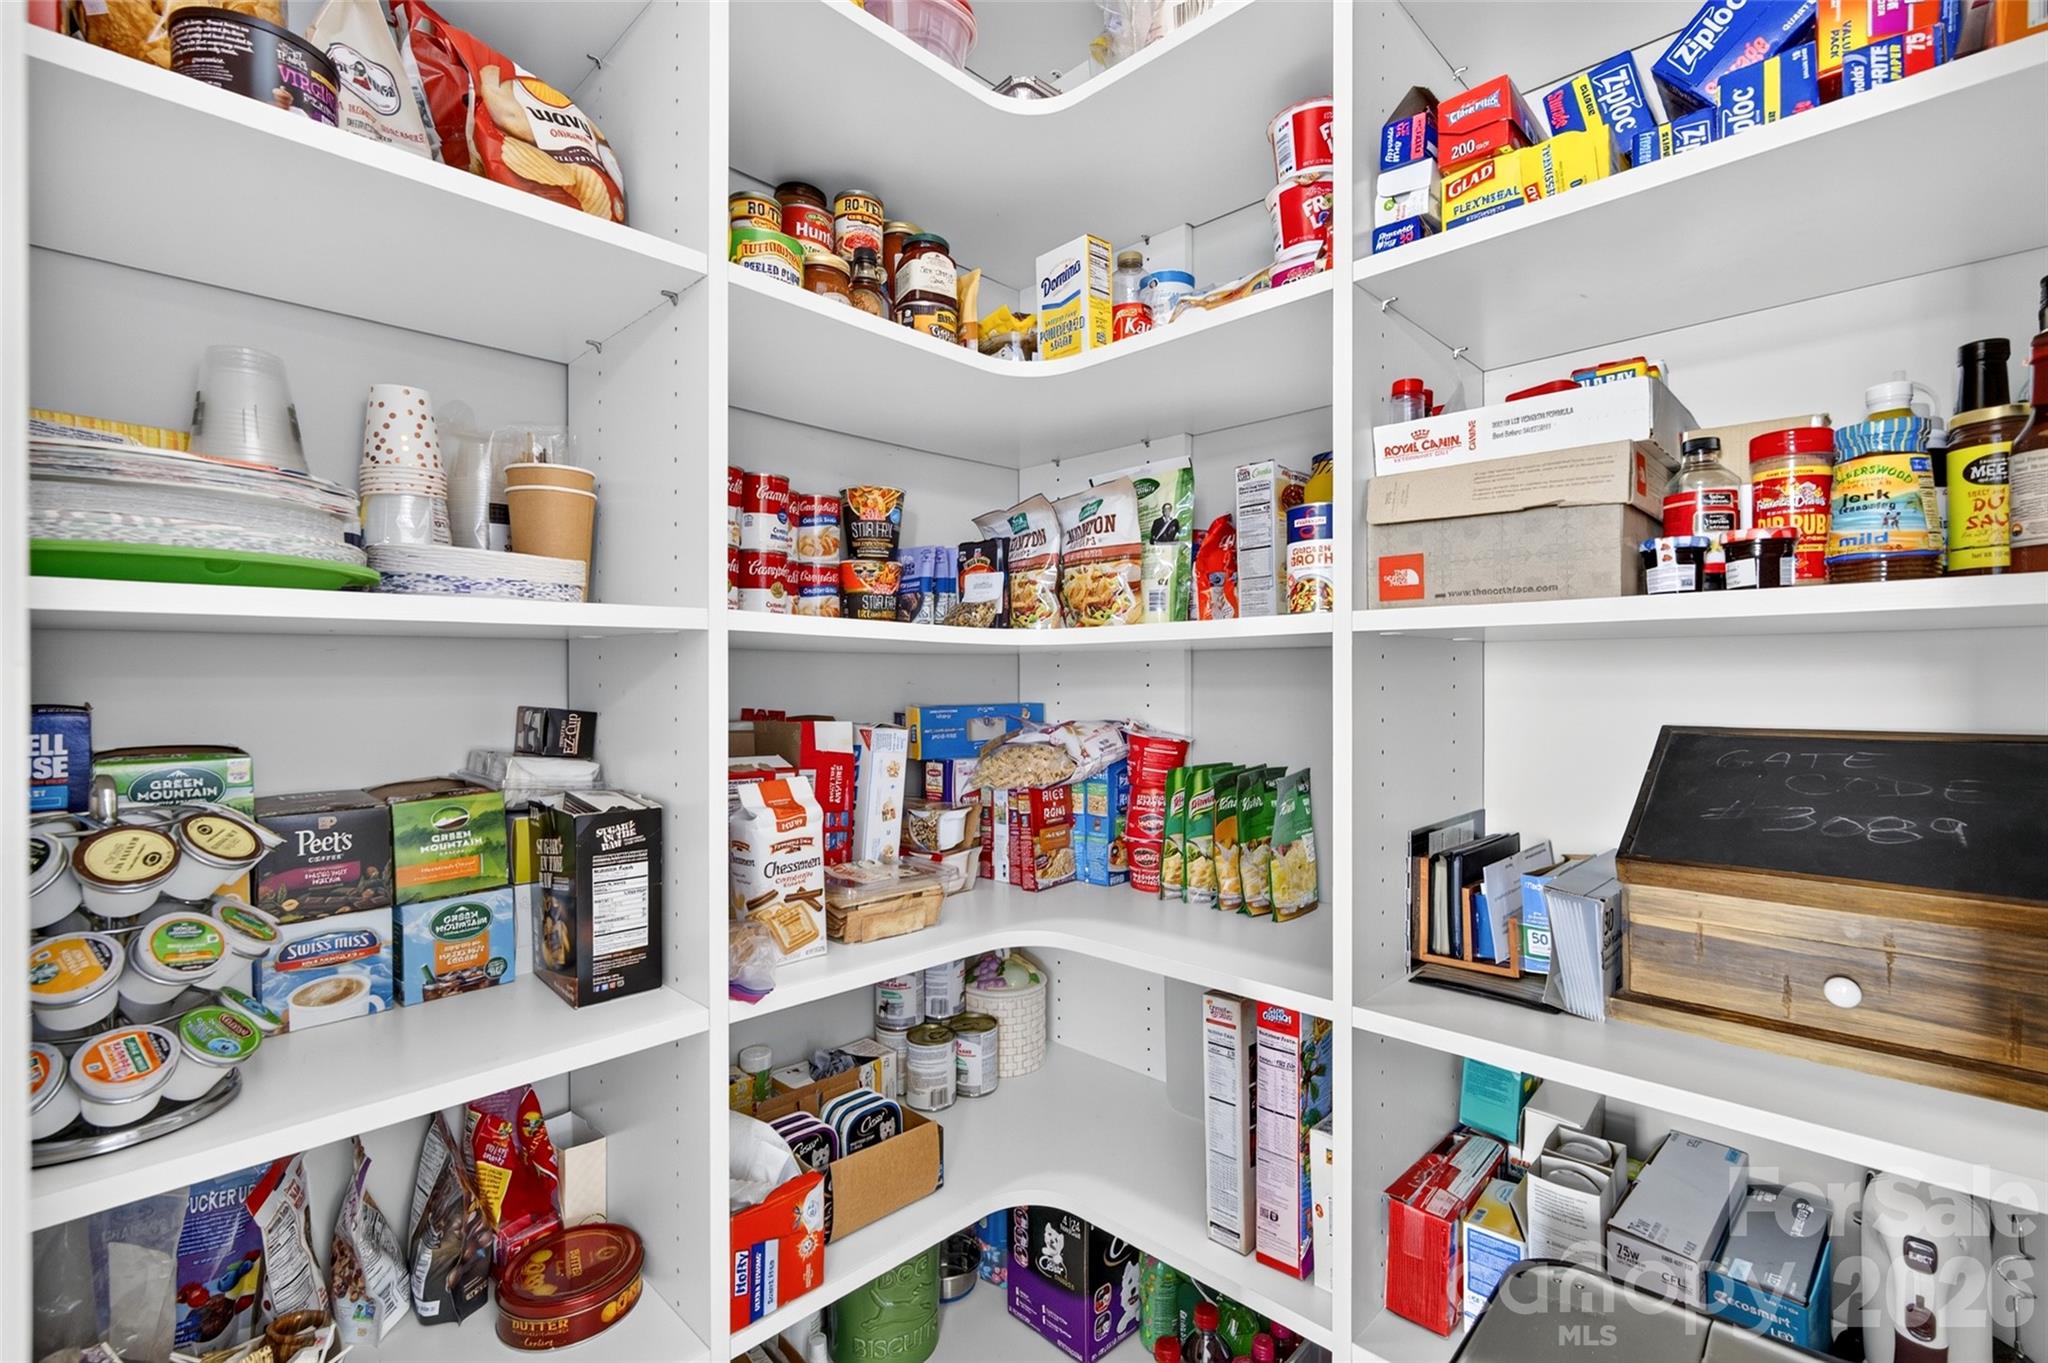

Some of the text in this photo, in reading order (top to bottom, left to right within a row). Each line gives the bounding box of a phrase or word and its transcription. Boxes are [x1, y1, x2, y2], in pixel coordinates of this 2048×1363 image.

[1451, 138, 1476, 160] 200
[1448, 165, 1494, 199] GLAD
[1384, 442, 1420, 458] ROYAL
[1839, 531, 1889, 548] mild
[1717, 749, 1893, 769] GATE
[136, 786, 218, 801] MOUNTAIN
[150, 777, 204, 790] GREEN
[1785, 773, 1992, 804] CODE
[294, 829, 353, 857] Peet's
